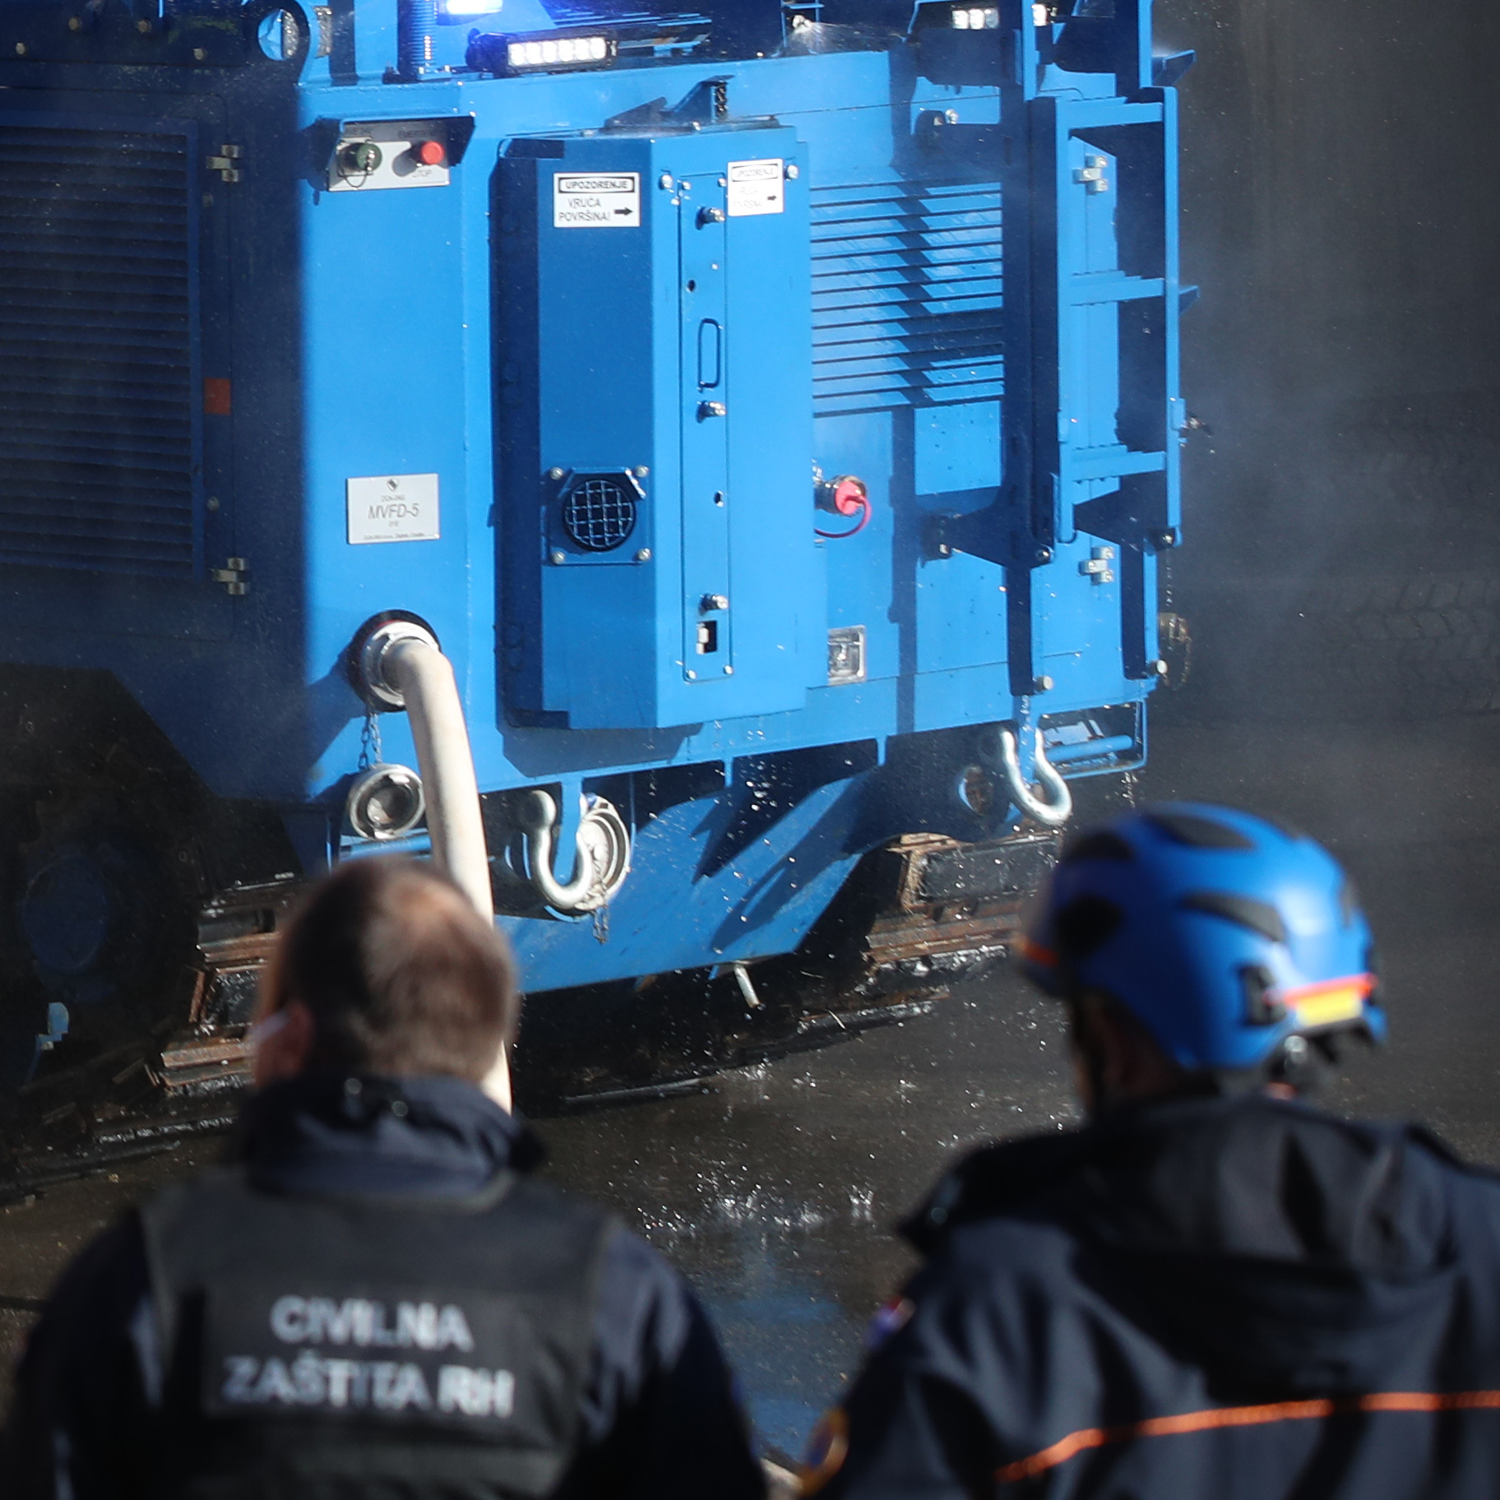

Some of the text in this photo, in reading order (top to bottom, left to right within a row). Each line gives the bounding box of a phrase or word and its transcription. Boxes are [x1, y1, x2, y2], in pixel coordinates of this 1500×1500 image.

[565, 180, 628, 189] UPOZORENJE
[269, 1294, 475, 1352] CIVILNA
[221, 1349, 516, 1419] ZAŠTITA RH
